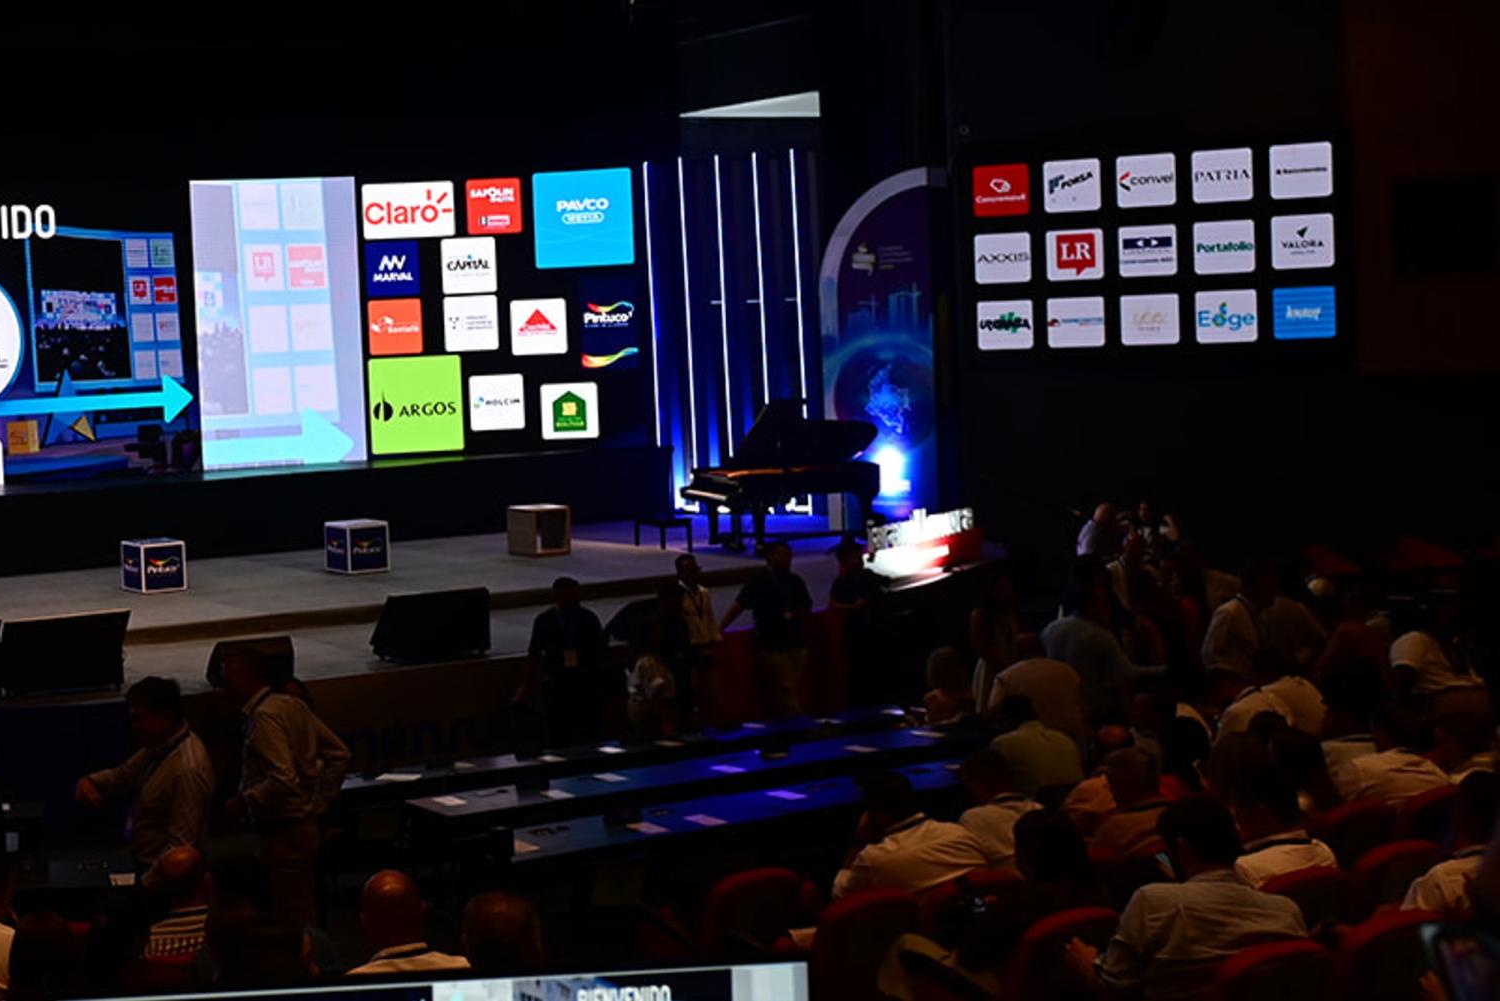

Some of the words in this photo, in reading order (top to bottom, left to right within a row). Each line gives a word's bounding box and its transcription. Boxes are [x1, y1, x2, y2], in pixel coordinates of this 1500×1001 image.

[1194, 168, 1251, 184] PATRIA
[364, 202, 439, 225] Claro
[556, 197, 609, 213] PAVCO
[1060, 242, 1092, 261] LR
[1198, 302, 1255, 331] Edge
[399, 401, 457, 418] ARGOS
